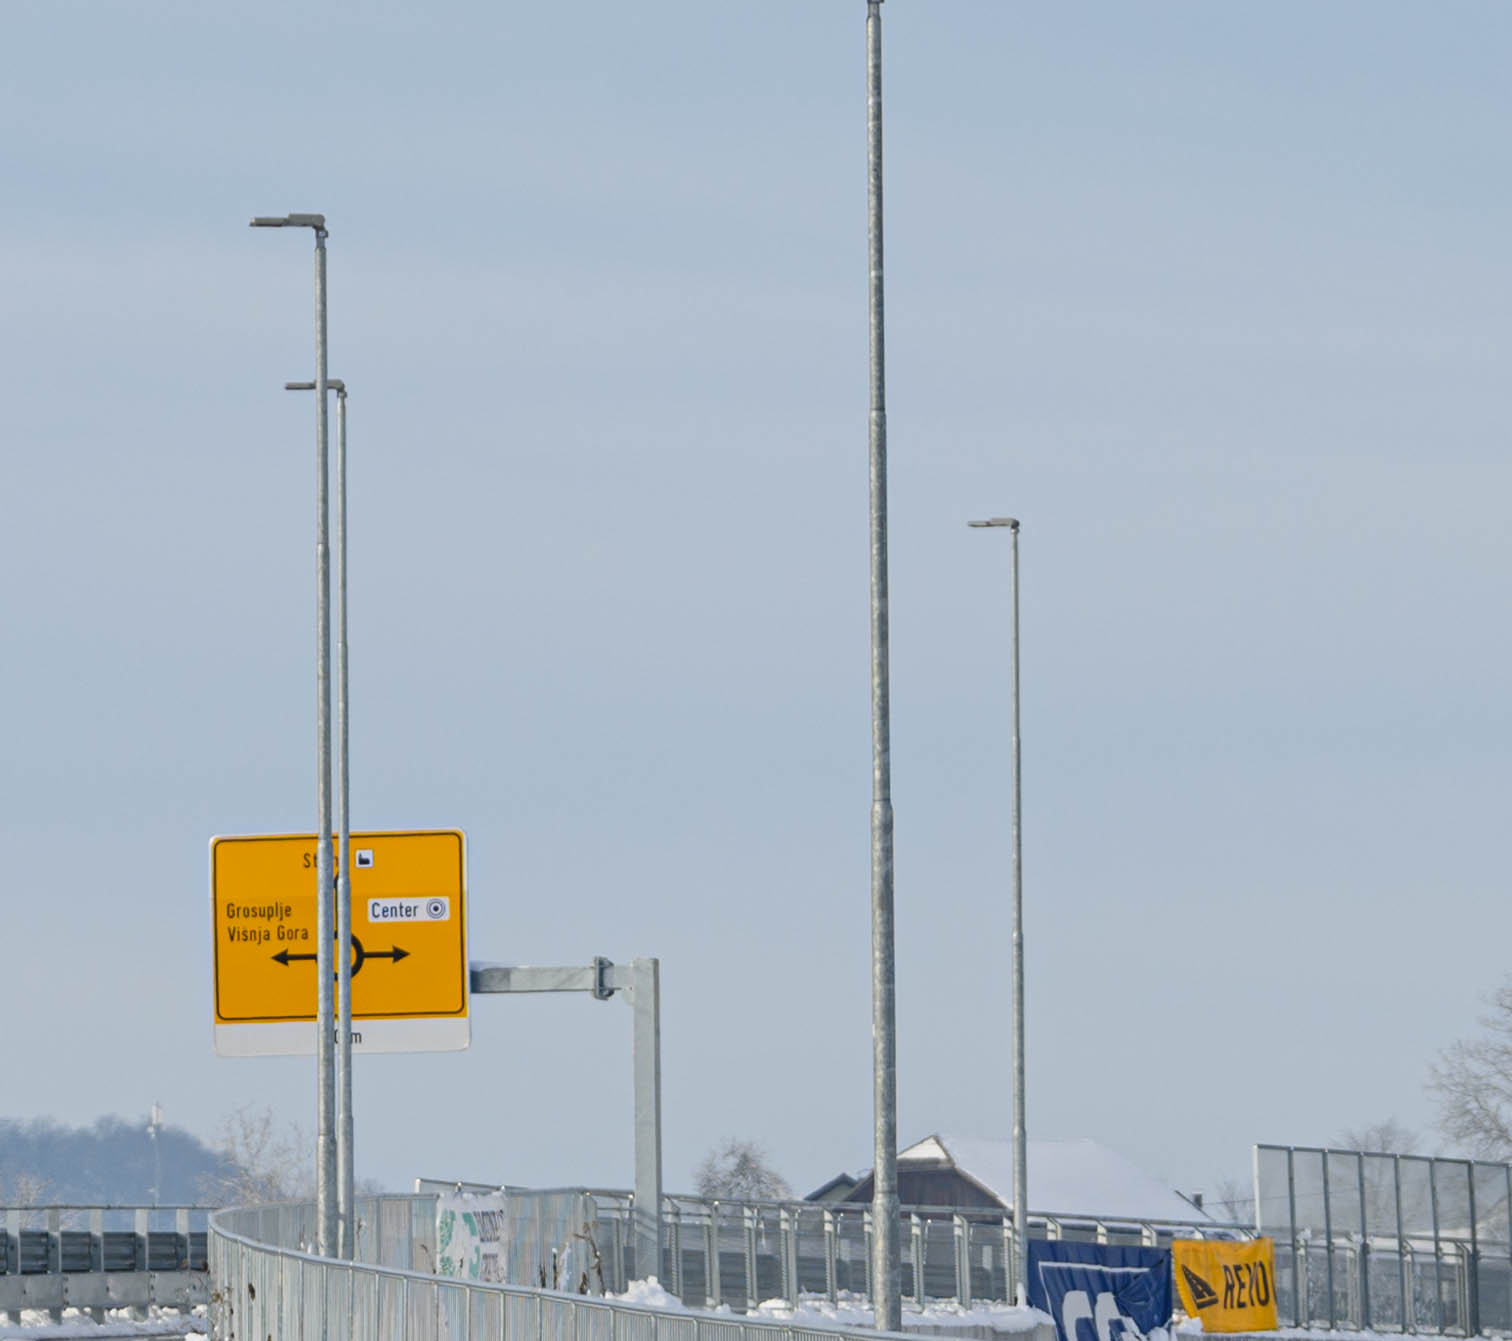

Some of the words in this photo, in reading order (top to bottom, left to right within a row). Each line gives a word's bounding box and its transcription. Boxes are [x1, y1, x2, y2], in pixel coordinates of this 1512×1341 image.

[226, 901, 292, 921] Grosuplje
[371, 902, 419, 918] Center
[277, 925, 309, 940] Gora
